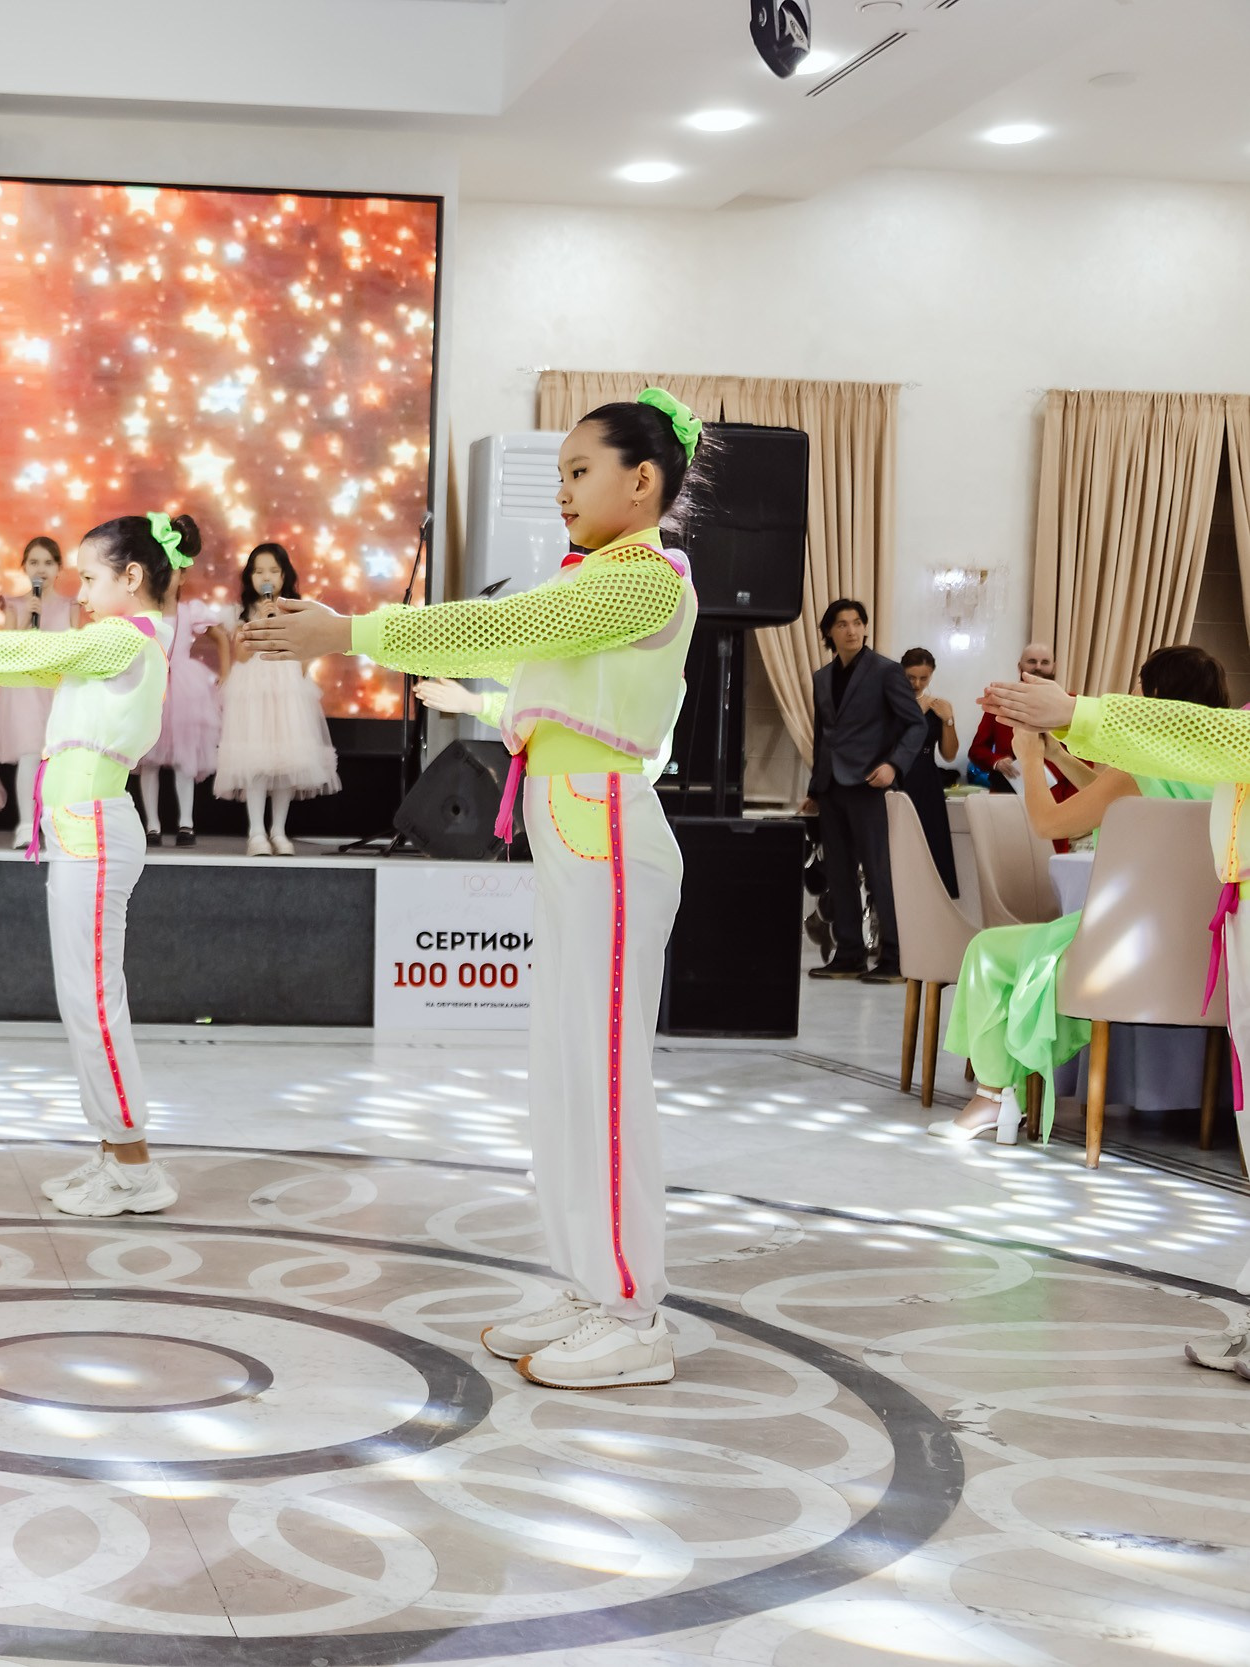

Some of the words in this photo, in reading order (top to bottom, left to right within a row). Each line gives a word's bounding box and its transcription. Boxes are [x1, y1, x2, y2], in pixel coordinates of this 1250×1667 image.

[416, 931, 534, 951] СЕРТИФИ
[394, 962, 447, 988] 100
[458, 962, 519, 989] 000
